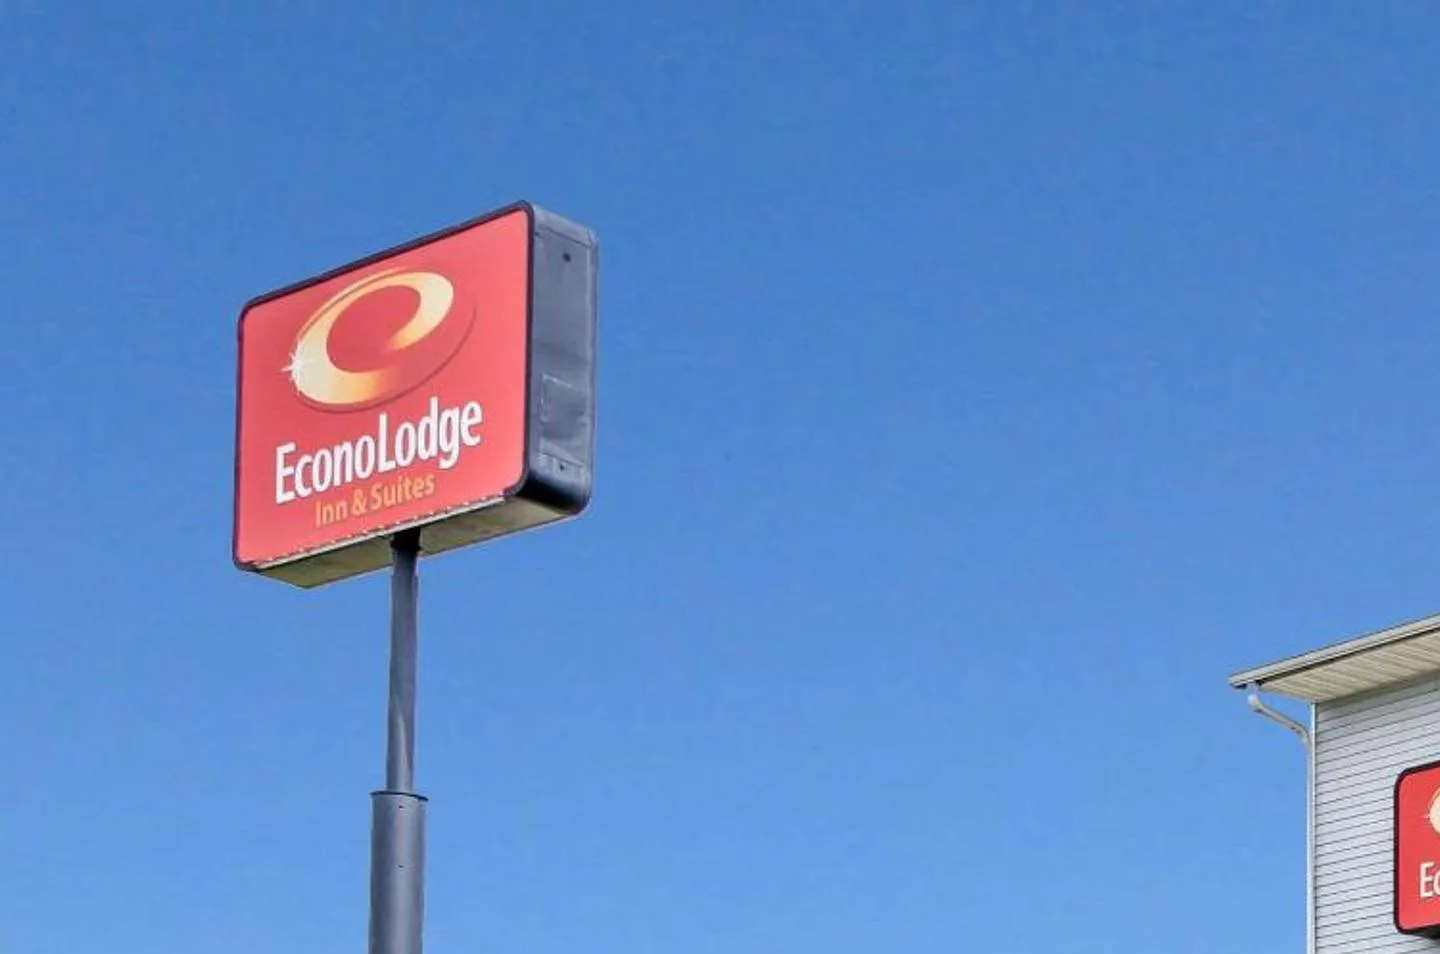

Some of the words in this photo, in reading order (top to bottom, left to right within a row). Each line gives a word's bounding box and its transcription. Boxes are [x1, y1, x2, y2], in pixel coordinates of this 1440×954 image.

[275, 396, 483, 504] EconoLodge
[316, 499, 348, 527] Inn
[352, 492, 367, 517] &
[370, 474, 436, 511] Suites
